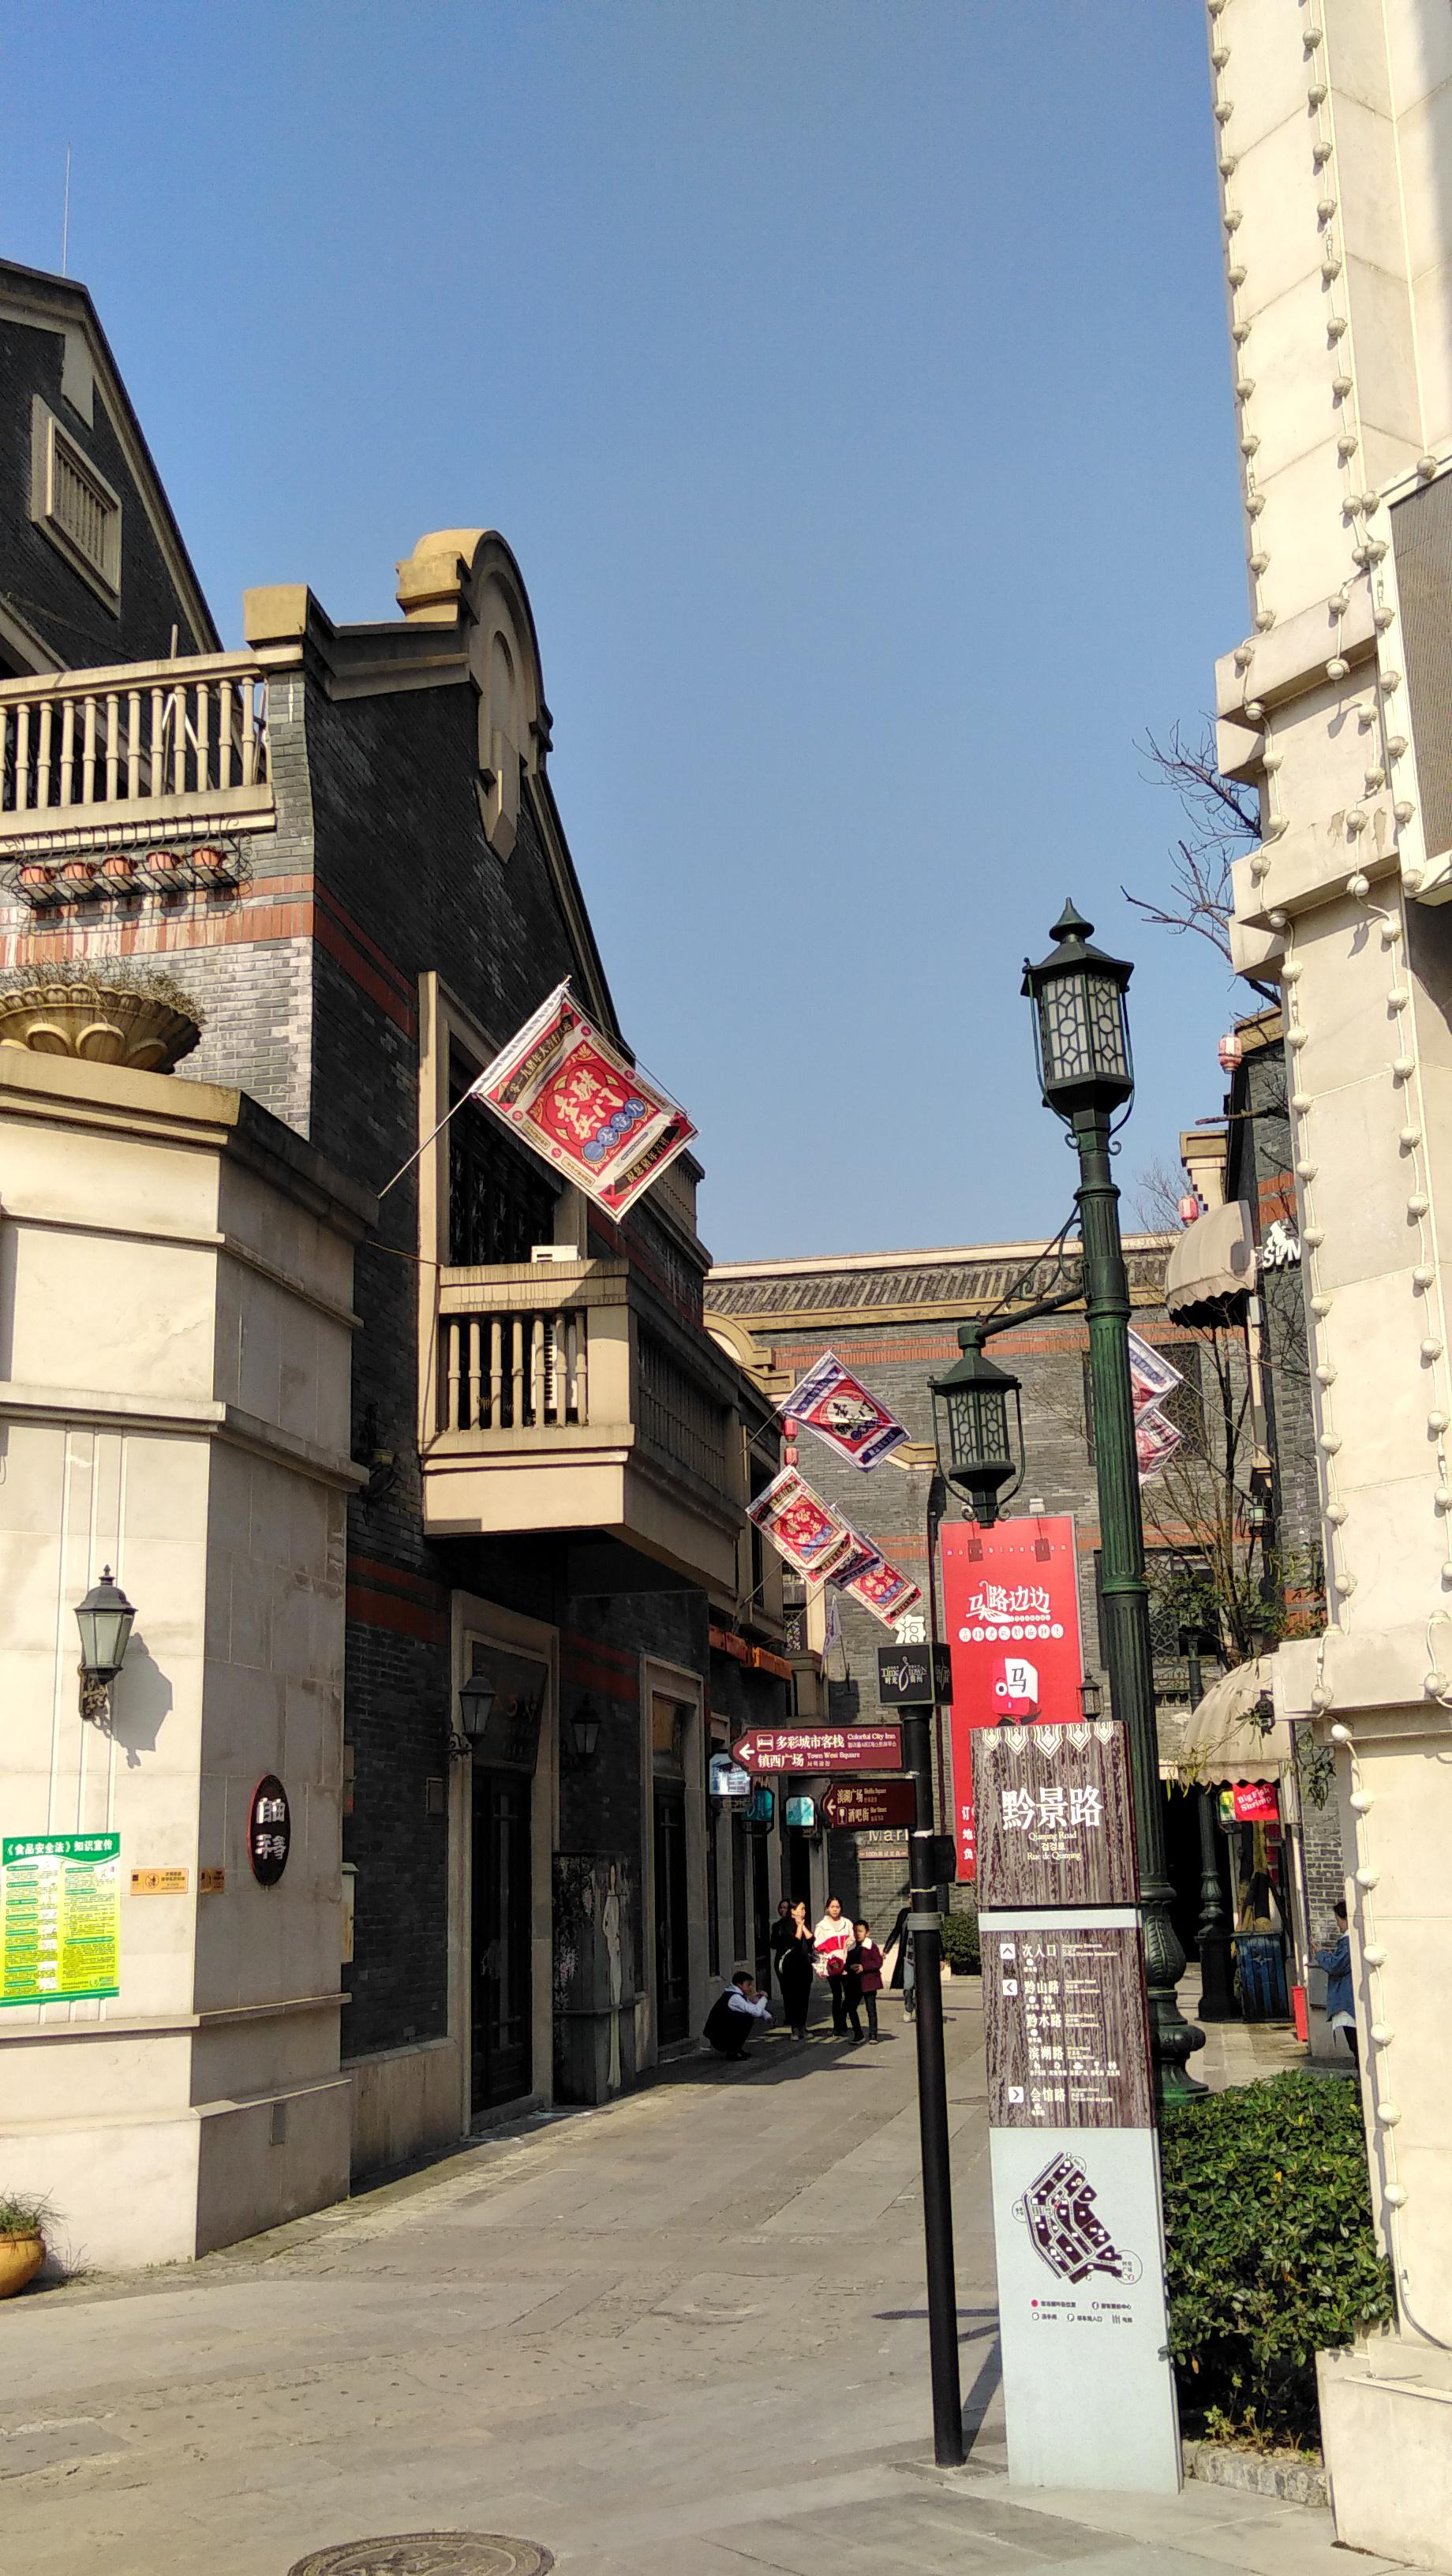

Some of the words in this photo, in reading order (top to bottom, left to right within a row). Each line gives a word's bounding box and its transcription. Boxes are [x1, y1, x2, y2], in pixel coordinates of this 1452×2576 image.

[966, 1585, 1051, 1621] 马路边边
[1009, 1668, 1027, 1693] 马
[777, 1734, 844, 1750] 多彩城市客栈
[758, 1754, 804, 1768] 镇西广场
[1001, 1785, 1103, 1830] 黔景路
[848, 1808, 869, 1822] 酒吧街
[1028, 1832, 1057, 1841] Qianjing
[1052, 1852, 1081, 1861] Qianjing
[1023, 1944, 1056, 1958] 次入口
[1024, 1980, 1059, 1994] 黔山路
[1026, 2013, 1061, 2027] 黔水路
[1028, 2046, 1064, 2060] 滨湖路
[1030, 2087, 1065, 2102] 会馆路
